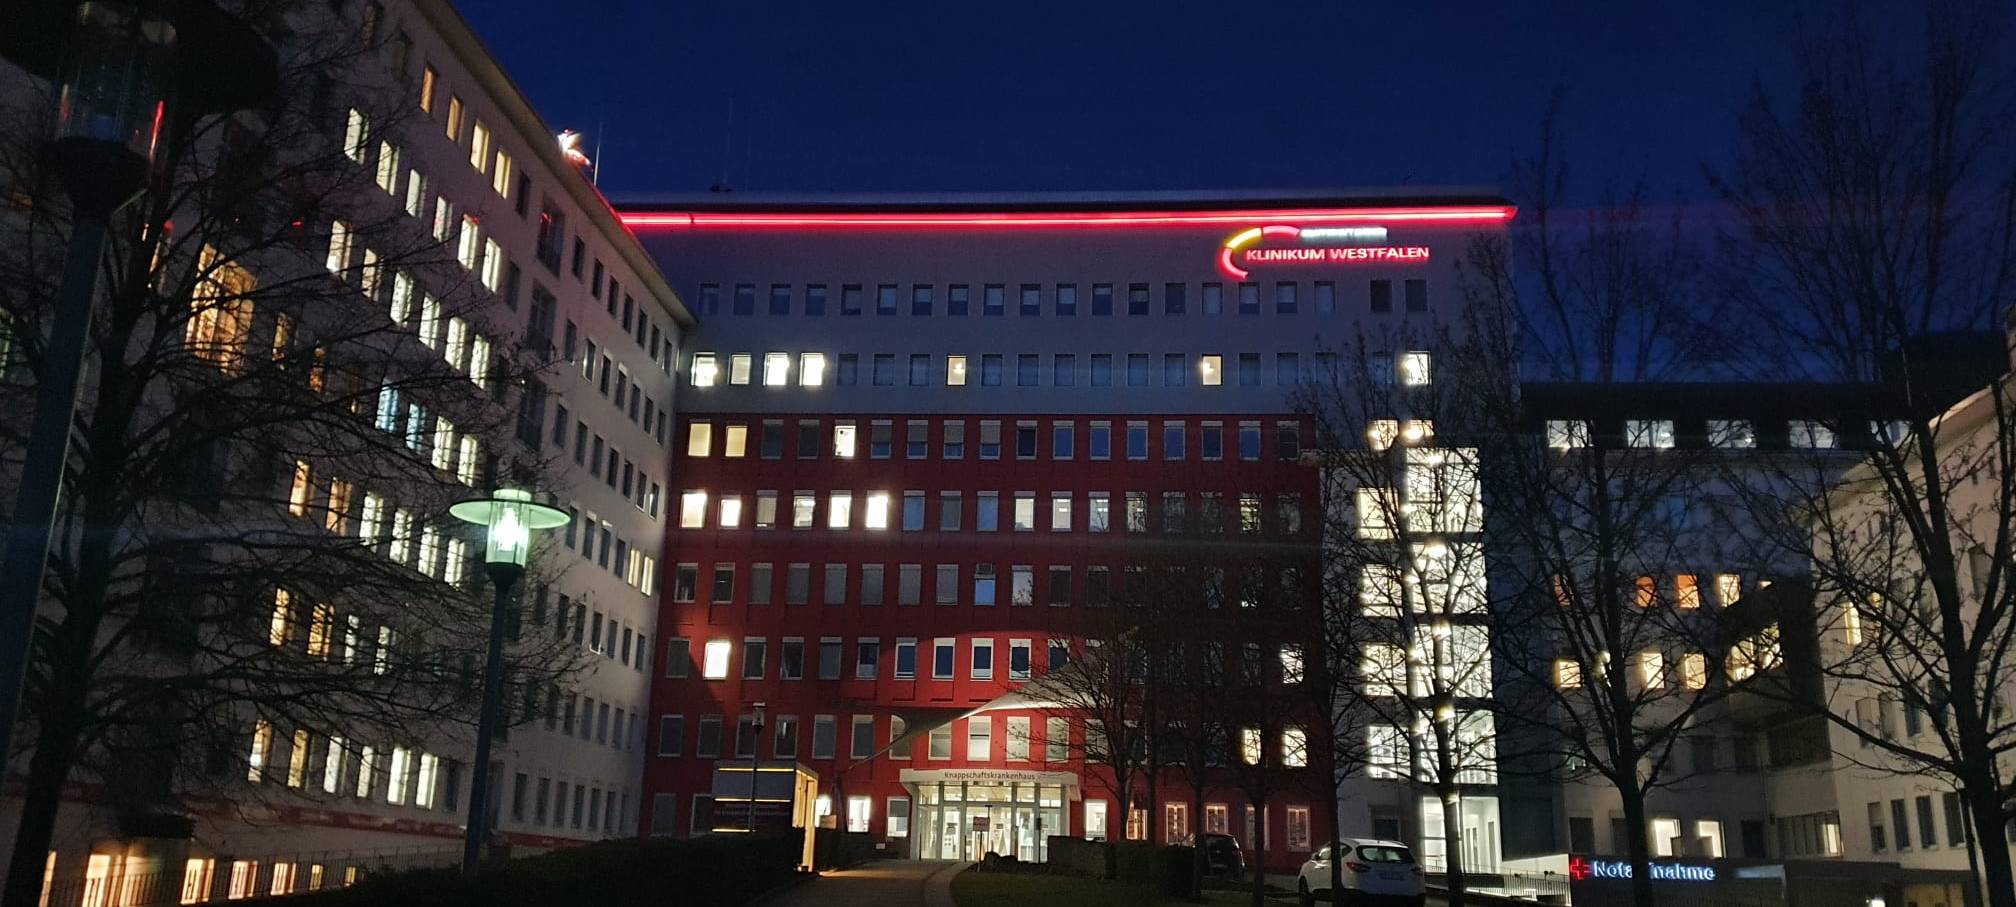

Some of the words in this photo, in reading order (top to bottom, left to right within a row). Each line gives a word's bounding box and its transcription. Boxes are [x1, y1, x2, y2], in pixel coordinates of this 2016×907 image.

[1246, 248, 1325, 261] KLINIKUM
[1330, 247, 1429, 260] WESTFALEN
[944, 771, 1036, 781] Knappschaftskrankenhaus
[1593, 859, 1716, 881] Notanahme
